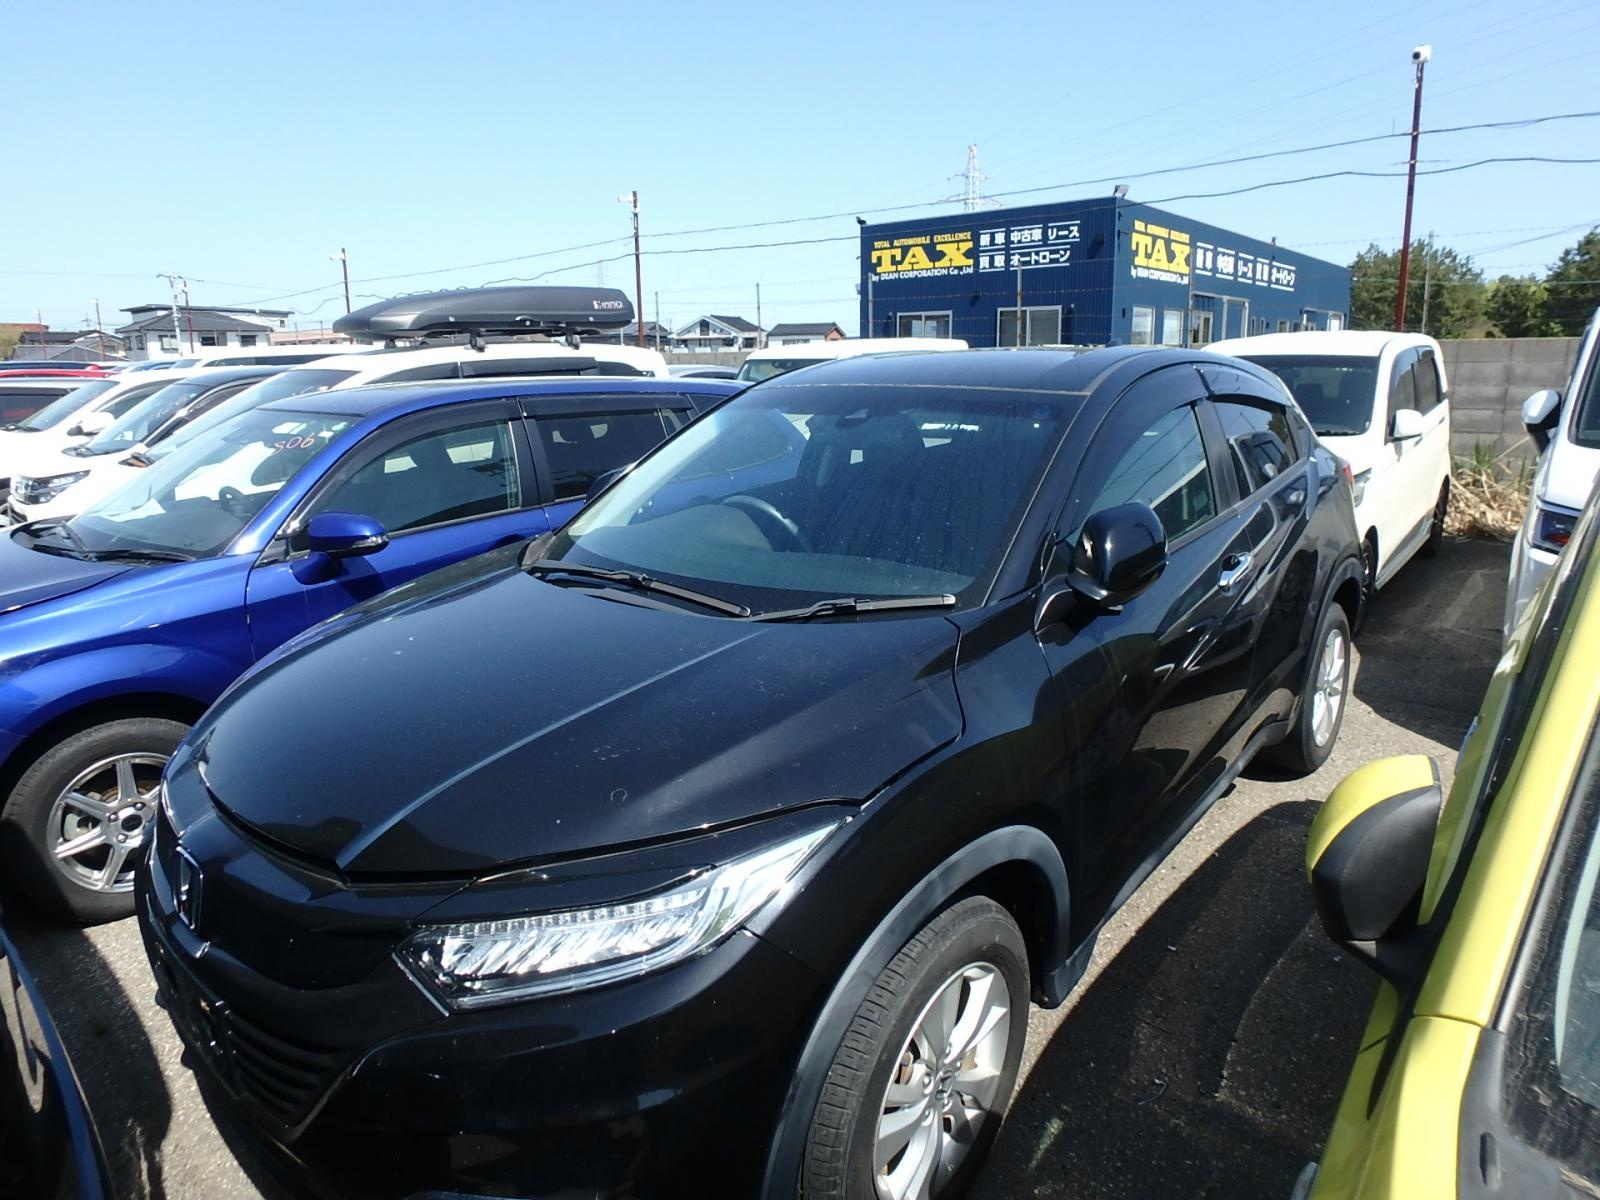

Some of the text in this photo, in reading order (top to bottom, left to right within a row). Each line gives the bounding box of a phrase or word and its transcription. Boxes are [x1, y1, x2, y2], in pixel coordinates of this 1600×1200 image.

[934, 231, 972, 243] EXCELLENCE
[1048, 226, 1079, 240] リース
[871, 241, 974, 273] TAX
[1010, 250, 1070, 266] オートローン
[1132, 232, 1190, 274] TAX
[900, 268, 949, 279] CORPORATION
